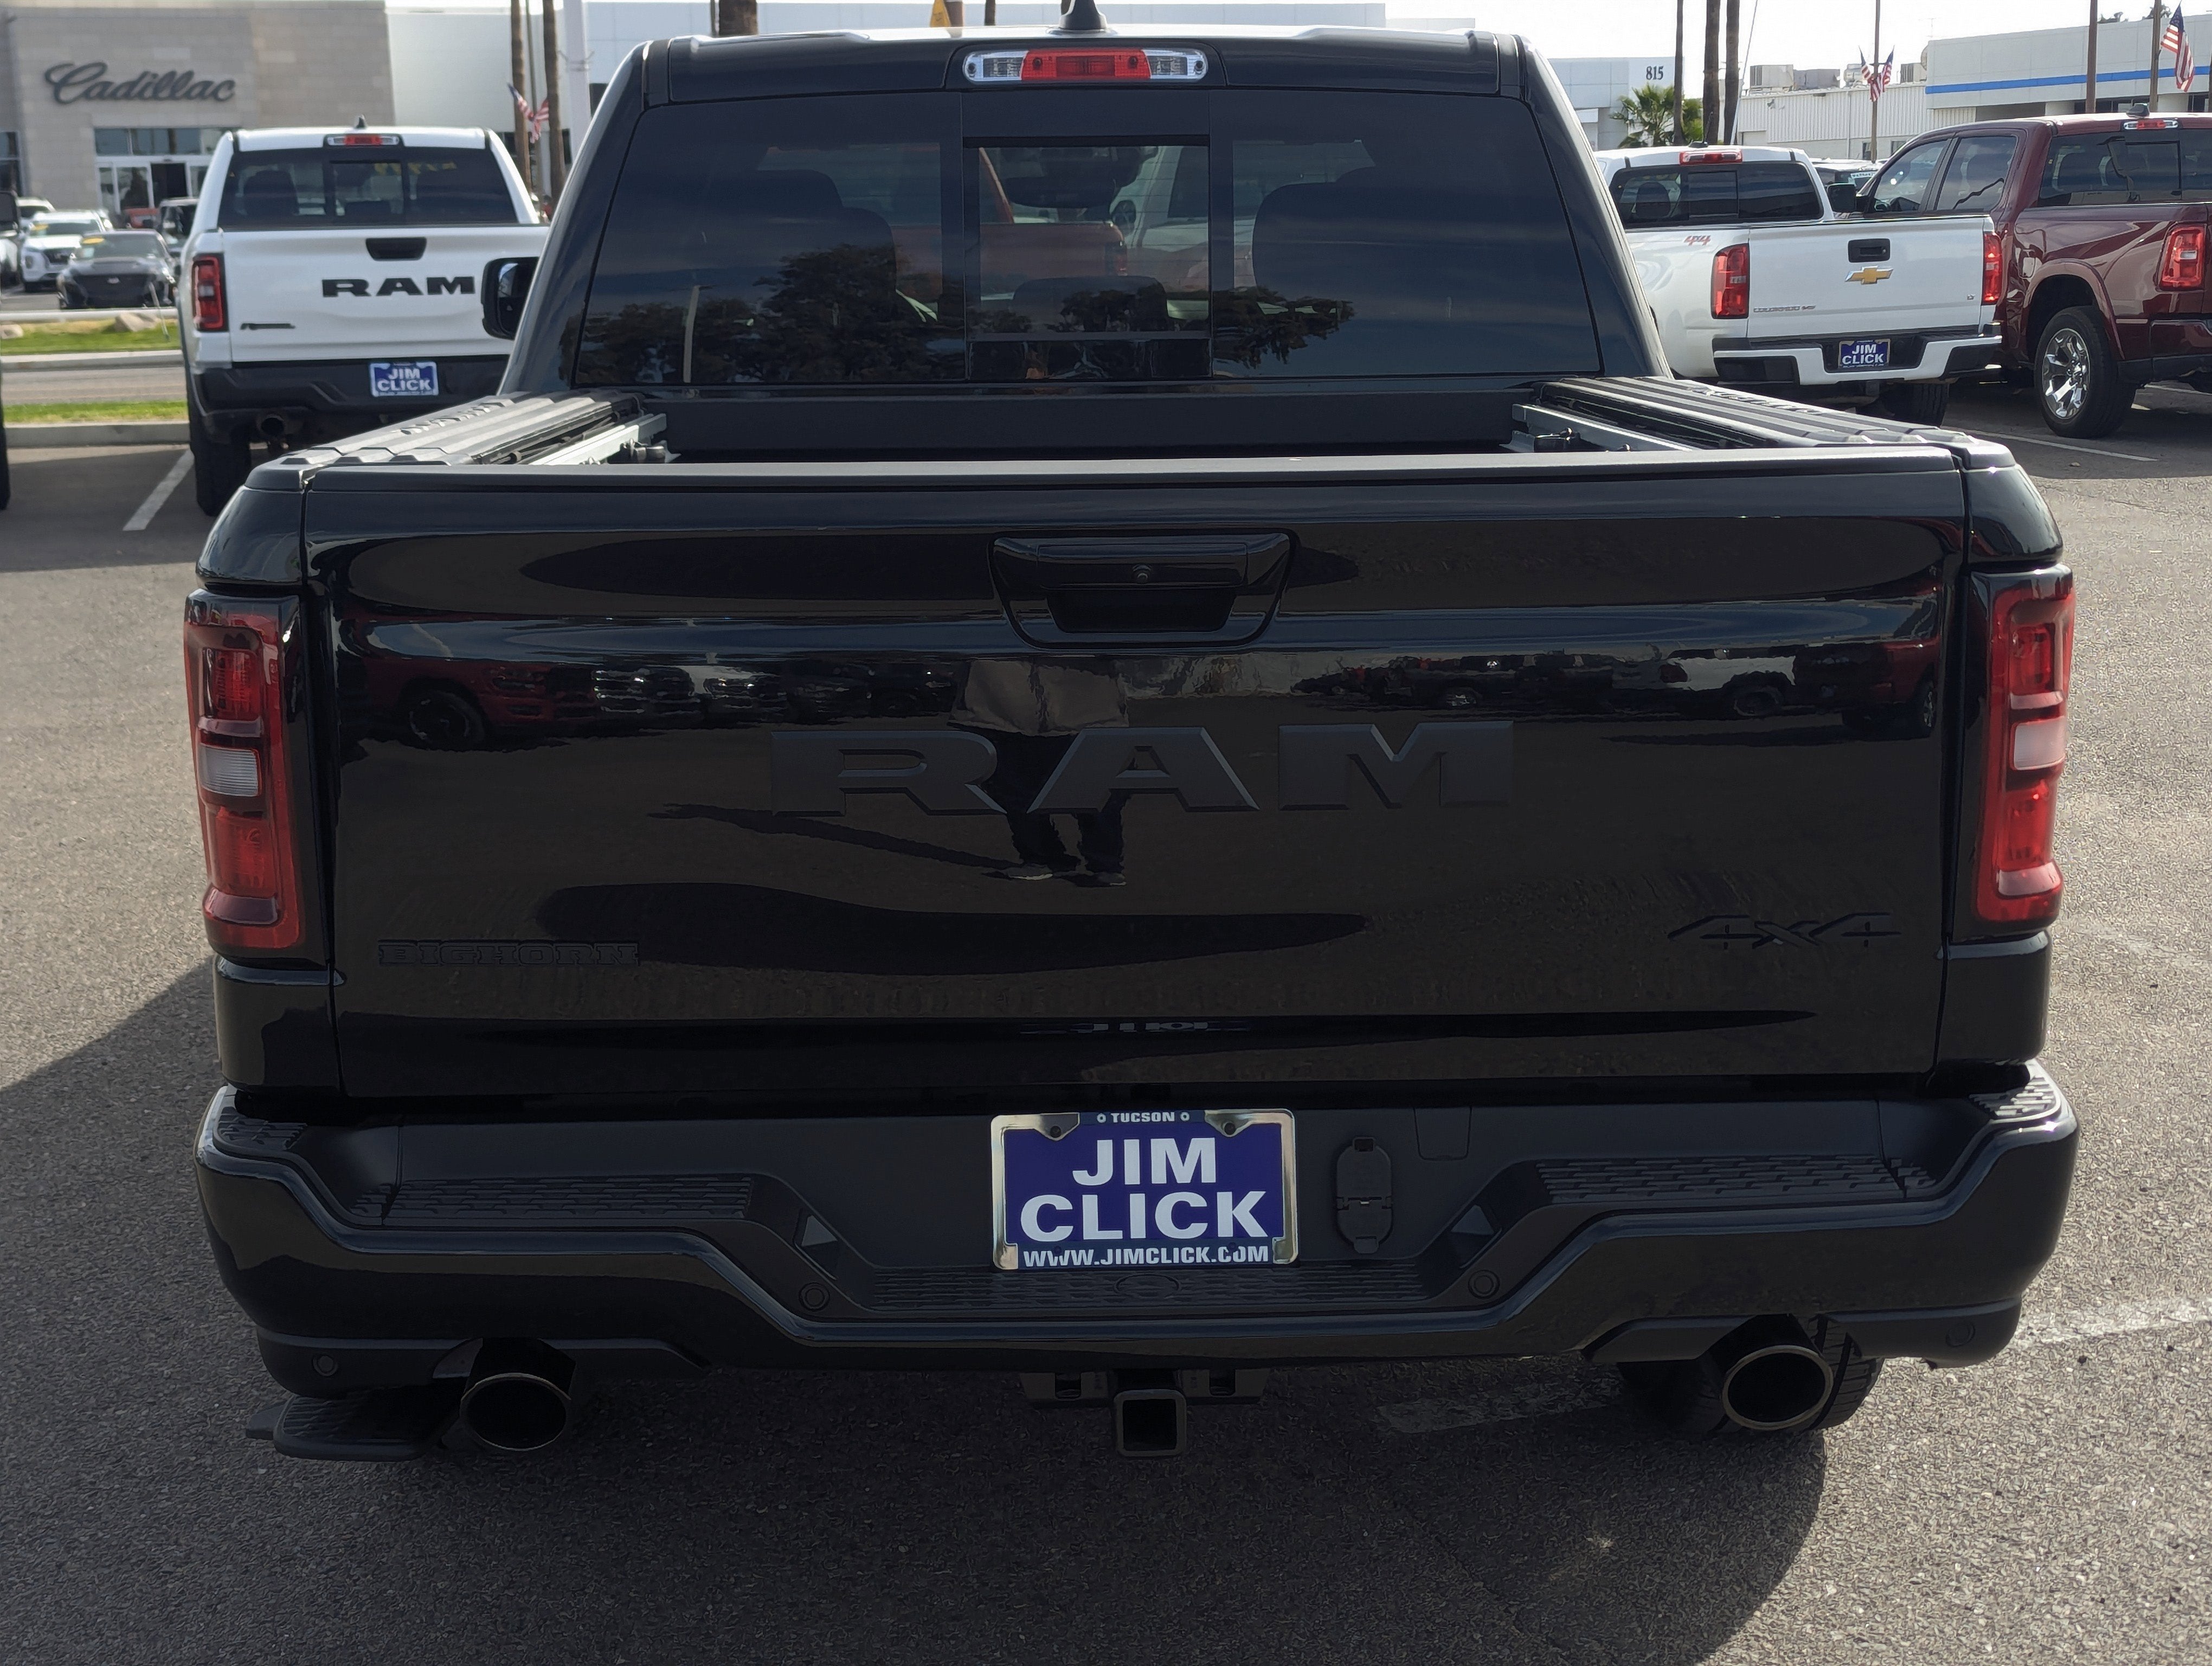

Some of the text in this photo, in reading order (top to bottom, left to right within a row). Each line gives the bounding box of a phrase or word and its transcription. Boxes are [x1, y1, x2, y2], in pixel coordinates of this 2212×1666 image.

[1645, 66, 1664, 80] 815
[44, 62, 235, 105] Cadillac
[321, 276, 475, 297] RAM
[1851, 344, 1876, 354] JIM
[1842, 354, 1884, 364] CLICK
[388, 368, 420, 380] JIM
[377, 379, 432, 392] CLICK
[771, 720, 1513, 817] RAM
[1110, 1112, 1175, 1123] TUCSON
[1072, 1137, 1217, 1186] JIM
[1020, 1191, 1269, 1242] CLICK
[1023, 1246, 1269, 1267] WWW.JIMCLICK.COM
